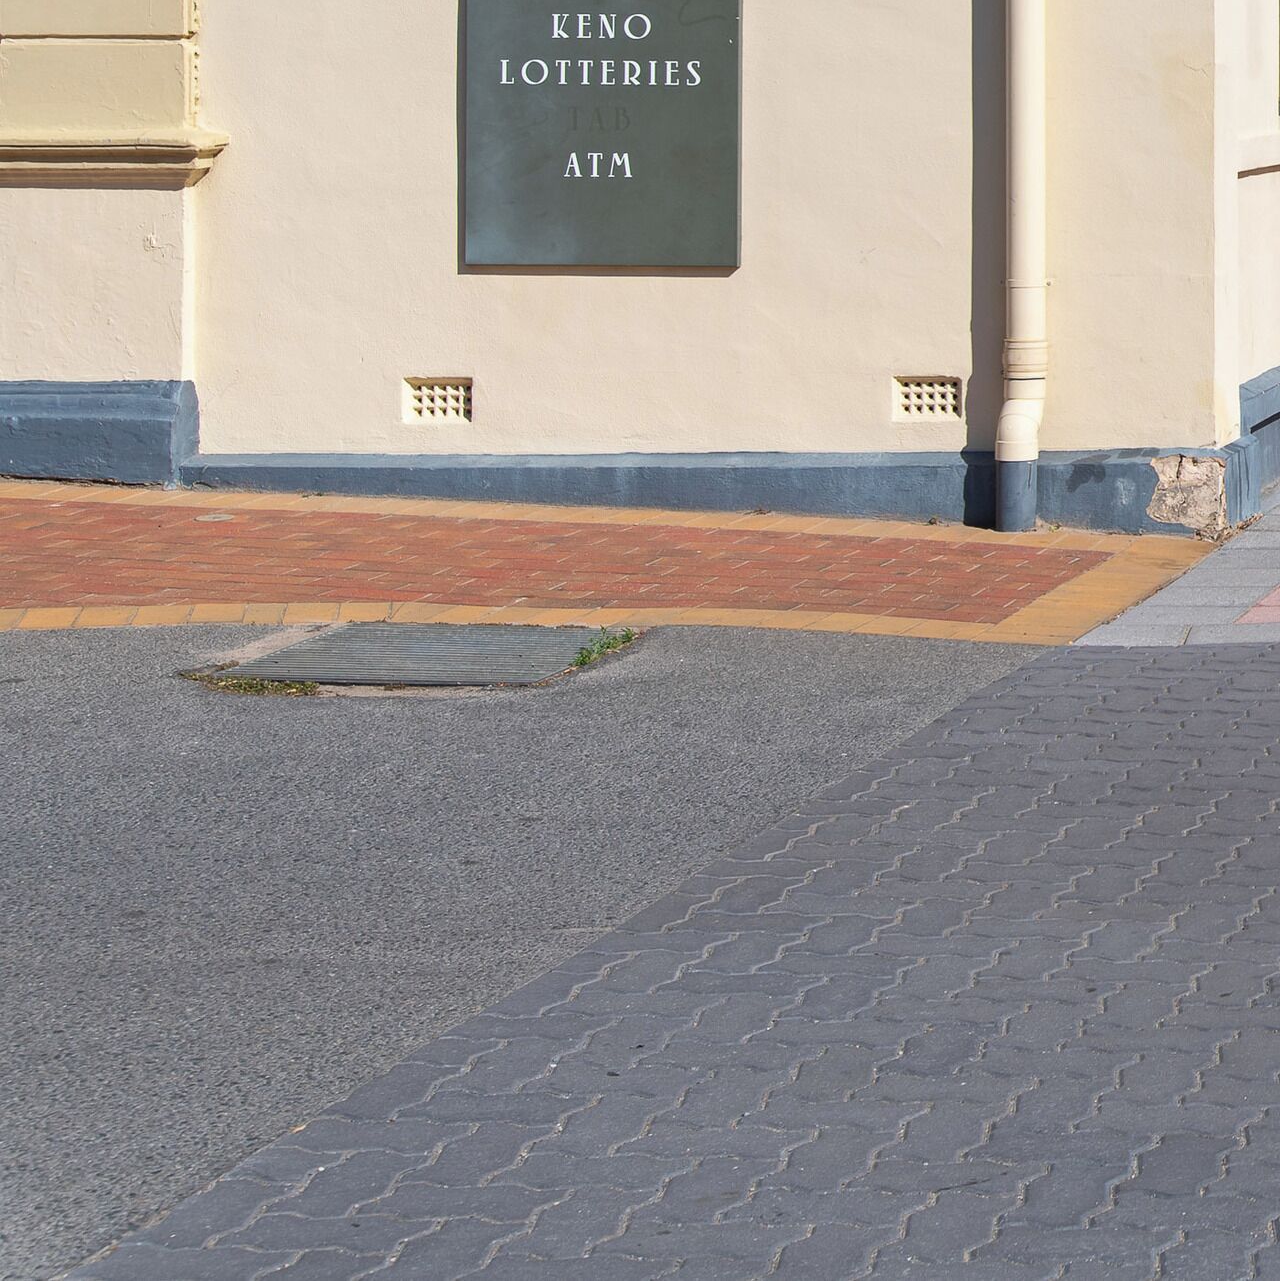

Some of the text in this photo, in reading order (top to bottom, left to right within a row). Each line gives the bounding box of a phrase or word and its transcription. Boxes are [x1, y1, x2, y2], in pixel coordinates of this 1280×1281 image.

[551, 13, 652, 40] KENO
[500, 59, 702, 87] LOTTERIES
[563, 152, 633, 178] ATM
